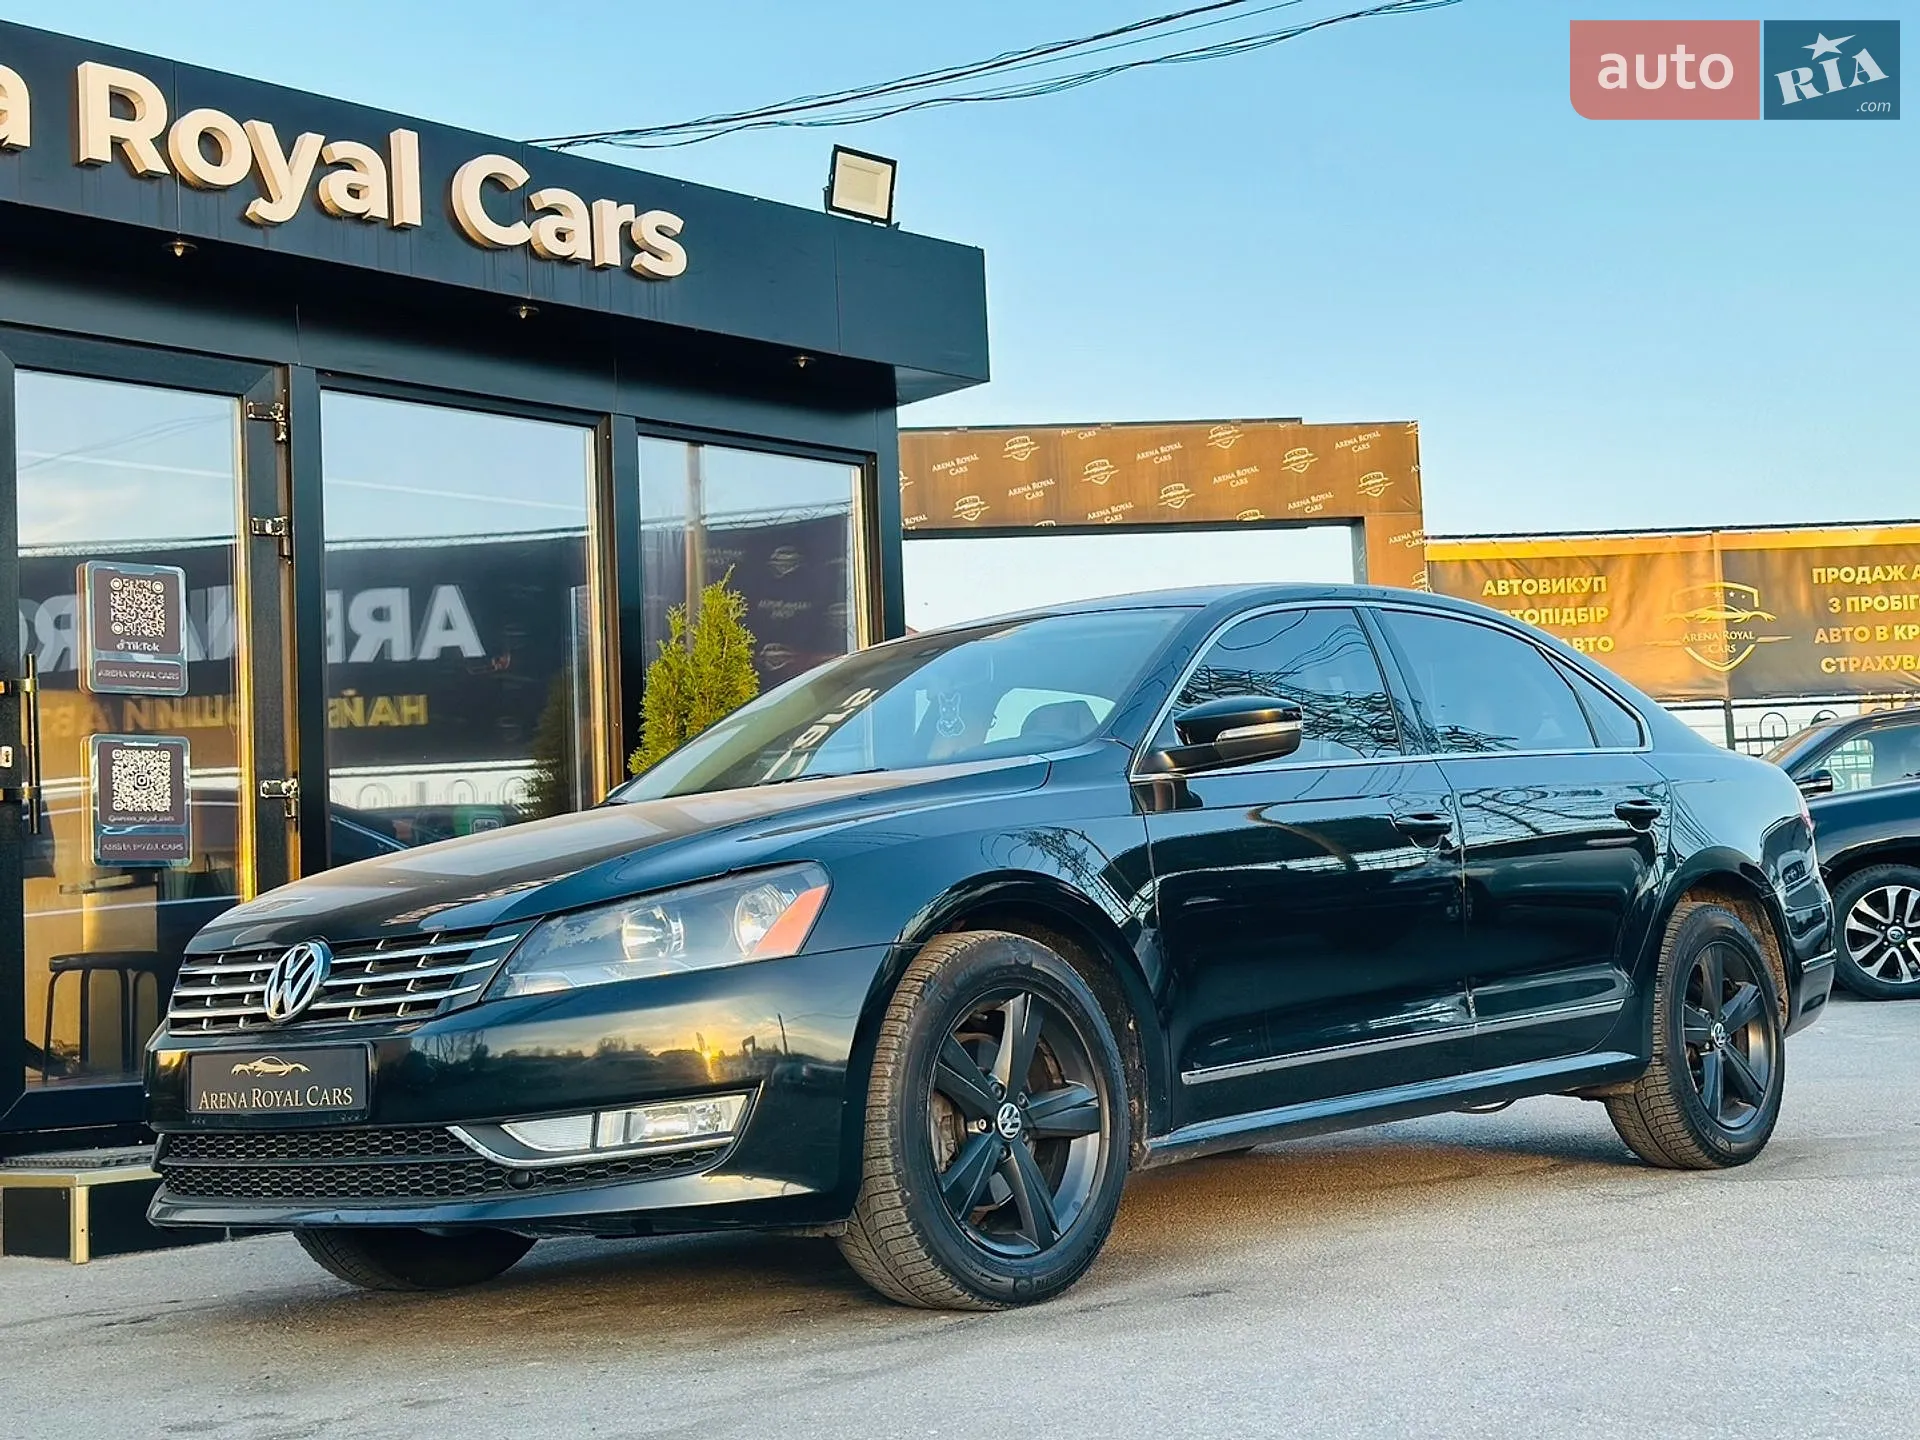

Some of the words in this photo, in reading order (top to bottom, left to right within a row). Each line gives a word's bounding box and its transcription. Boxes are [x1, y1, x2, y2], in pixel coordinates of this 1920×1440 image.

[75, 60, 422, 230] Royal
[451, 153, 688, 279] Cars
[1334, 437, 1358, 450] ARENA
[1358, 430, 1381, 443] ROYAL
[1351, 442, 1371, 453] CARS
[1136, 448, 1159, 461] ARENA
[1159, 441, 1183, 454] ROYAL
[1153, 453, 1172, 464] CARS
[931, 459, 956, 473] ARENA
[955, 453, 980, 466] ROYAL
[949, 466, 968, 476] CARS
[1212, 472, 1236, 485] ARENA
[1236, 465, 1260, 477] ROYAL
[1229, 477, 1249, 488] CARS
[1008, 485, 1032, 498] ARENA
[1031, 478, 1055, 491] ROYAL
[1024, 489, 1044, 501] CARS
[1287, 498, 1311, 511] ARENA
[1311, 491, 1335, 504] ROYAL
[1303, 503, 1323, 514] CARS
[1087, 508, 1110, 521] ARENA
[1110, 501, 1134, 514] ROYAL
[1104, 513, 1123, 524] CARS
[1812, 564, 1908, 585] ПРОДАЖ
[1482, 575, 1607, 597] АВТОВИКУП
[1828, 597, 1841, 613] З
[1846, 594, 1920, 613] ПРОБІГ
[1561, 635, 1615, 653] ВТО
[1683, 632, 1719, 643] ARENA
[1722, 630, 1755, 641] ROYAL
[1814, 625, 1871, 644] АВТО
[1875, 625, 1889, 641] В
[128, 640, 160, 652] TikTok
[1708, 643, 1736, 653] CARS
[198, 1090, 248, 1110] ARENA
[251, 1087, 304, 1109] ROYAL
[306, 1085, 353, 1107] CARS
